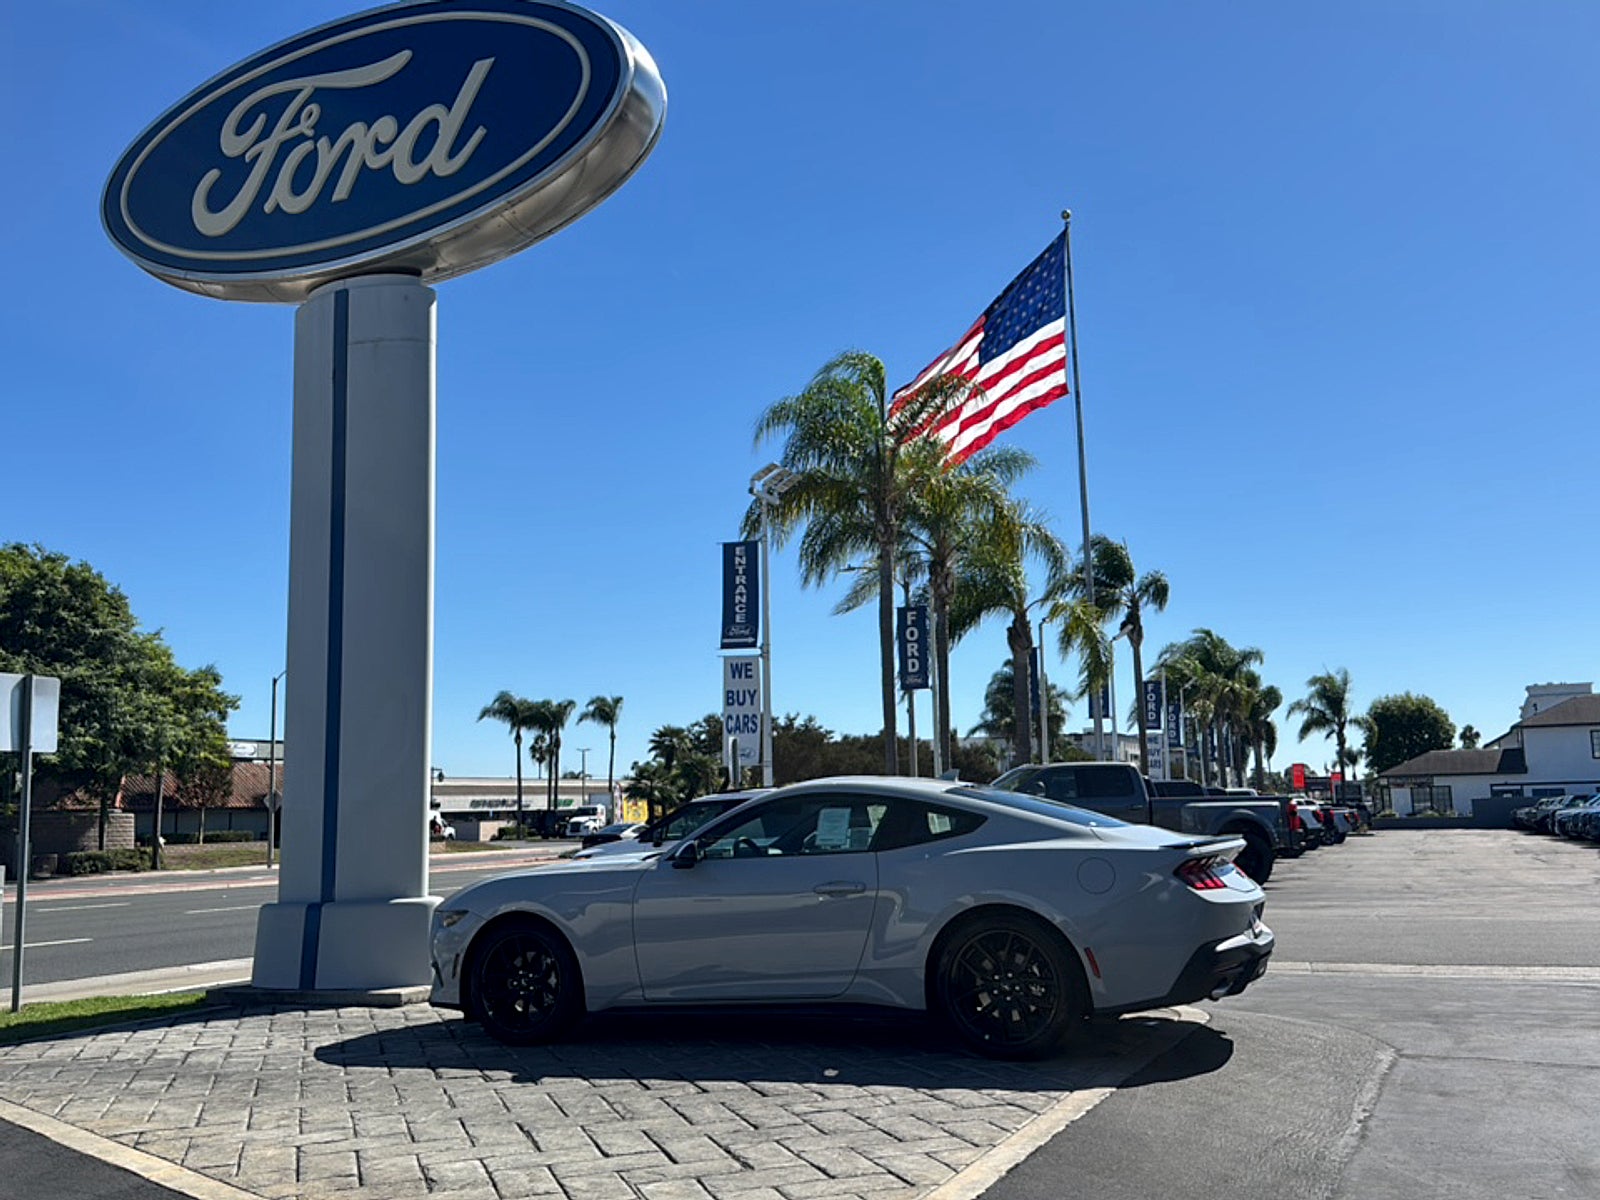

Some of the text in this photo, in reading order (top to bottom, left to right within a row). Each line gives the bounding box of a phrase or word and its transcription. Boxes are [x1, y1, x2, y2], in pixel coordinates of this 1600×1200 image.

[192, 49, 495, 236] Ford
[734, 546, 747, 623] ENTRANCE
[905, 611, 920, 673] FORD
[730, 662, 753, 680] WE
[726, 689, 757, 707] BUY
[1146, 683, 1157, 721] FORD
[725, 714, 758, 734] CARS
[1168, 705, 1177, 738] FORD
